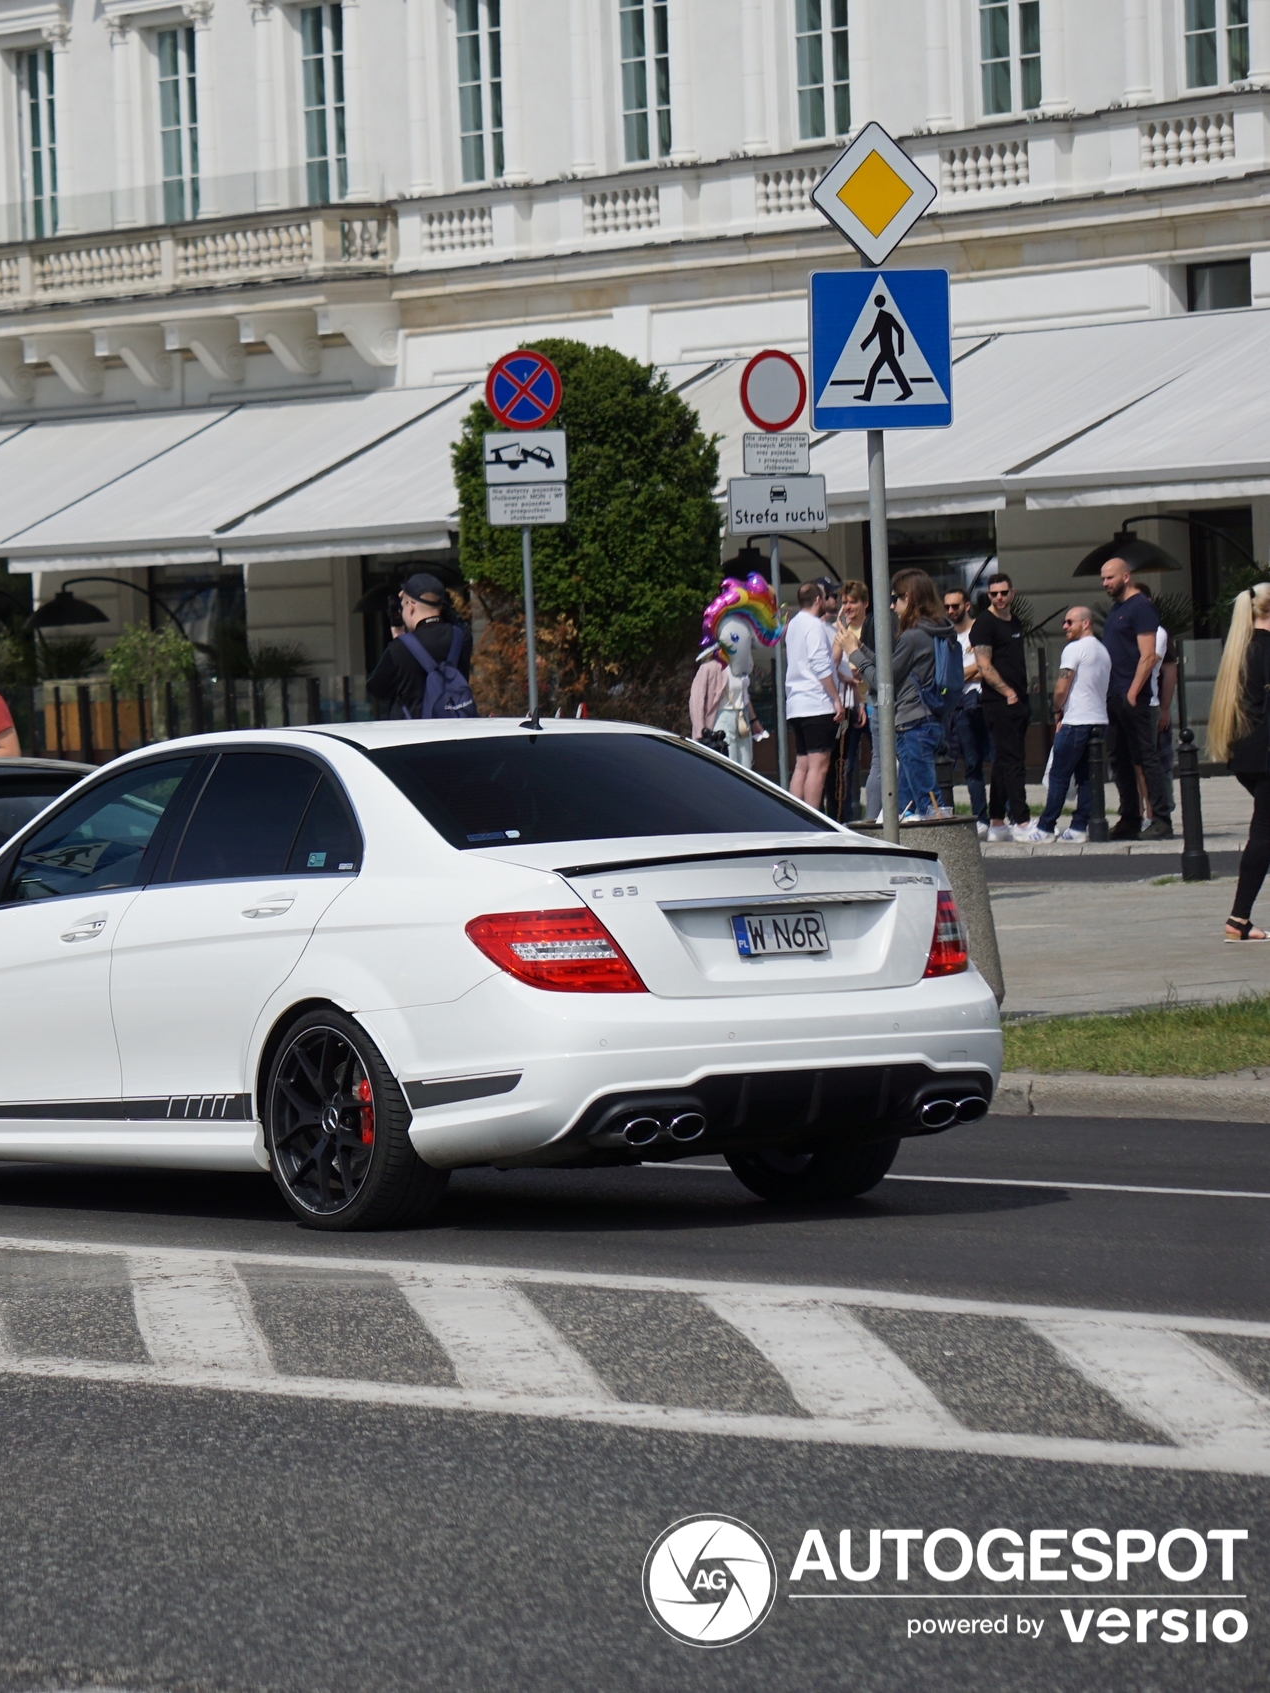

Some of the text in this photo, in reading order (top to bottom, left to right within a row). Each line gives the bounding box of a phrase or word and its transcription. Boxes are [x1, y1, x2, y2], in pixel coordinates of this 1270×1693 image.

[735, 506, 825, 525] Strefa ruchu
[591, 885, 638, 900] C 63
[747, 917, 825, 951] W N6R
[738, 939, 749, 949] PL
